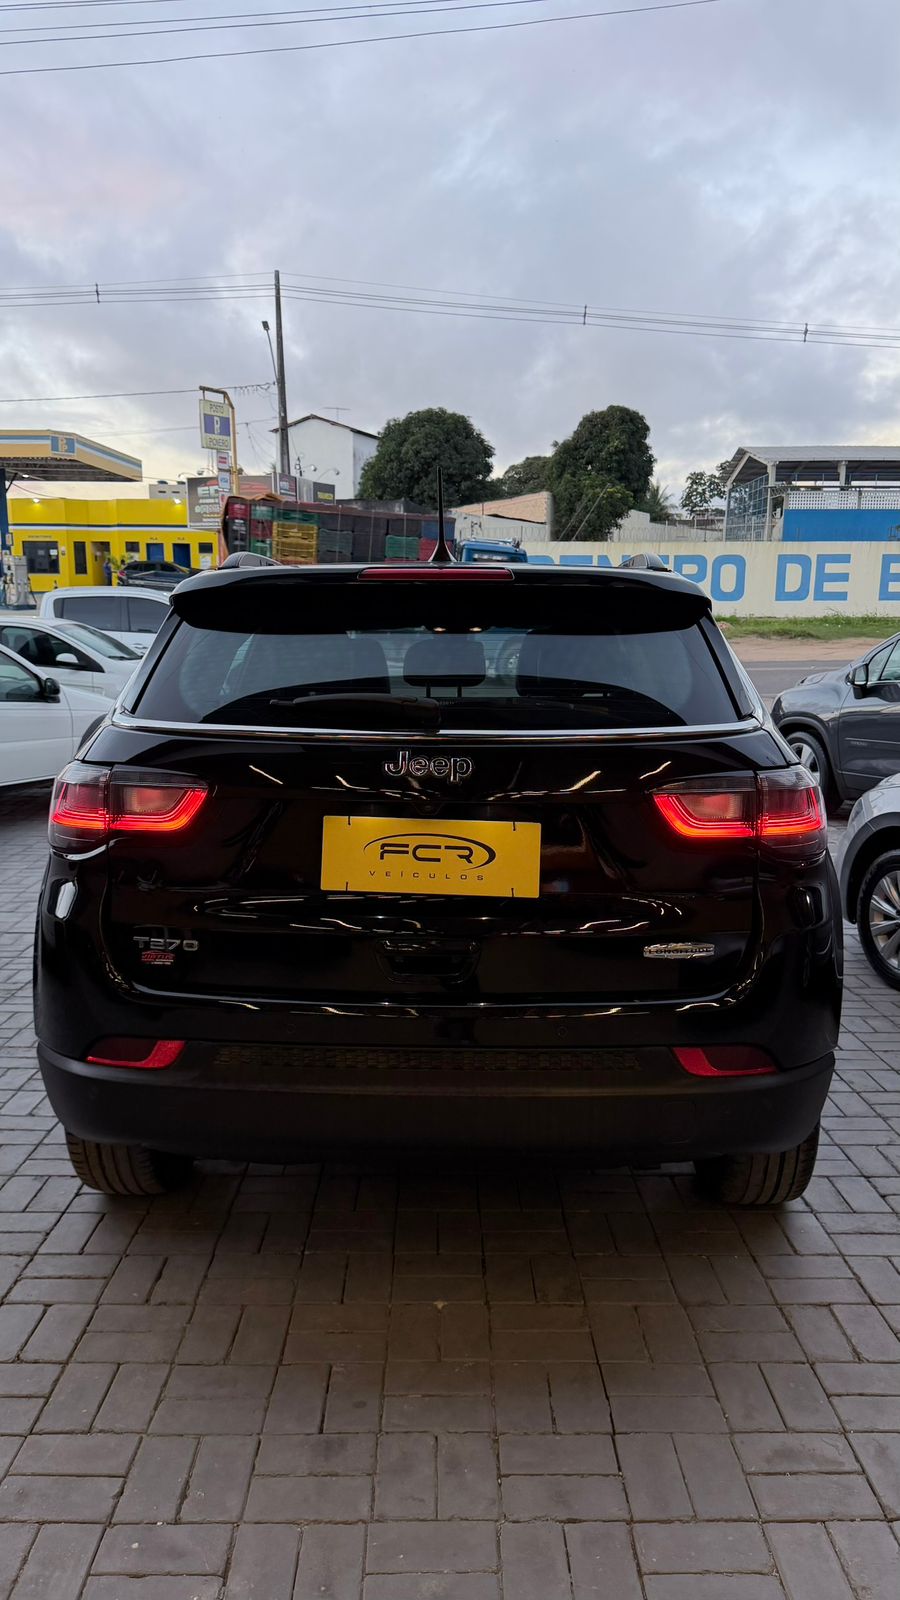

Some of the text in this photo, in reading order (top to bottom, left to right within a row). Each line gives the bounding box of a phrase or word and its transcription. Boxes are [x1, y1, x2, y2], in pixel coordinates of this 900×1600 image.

[775, 553, 852, 601] DE
[384, 751, 474, 783] Jeep
[379, 842, 474, 865] FCR
[133, 936, 199, 951] T270
